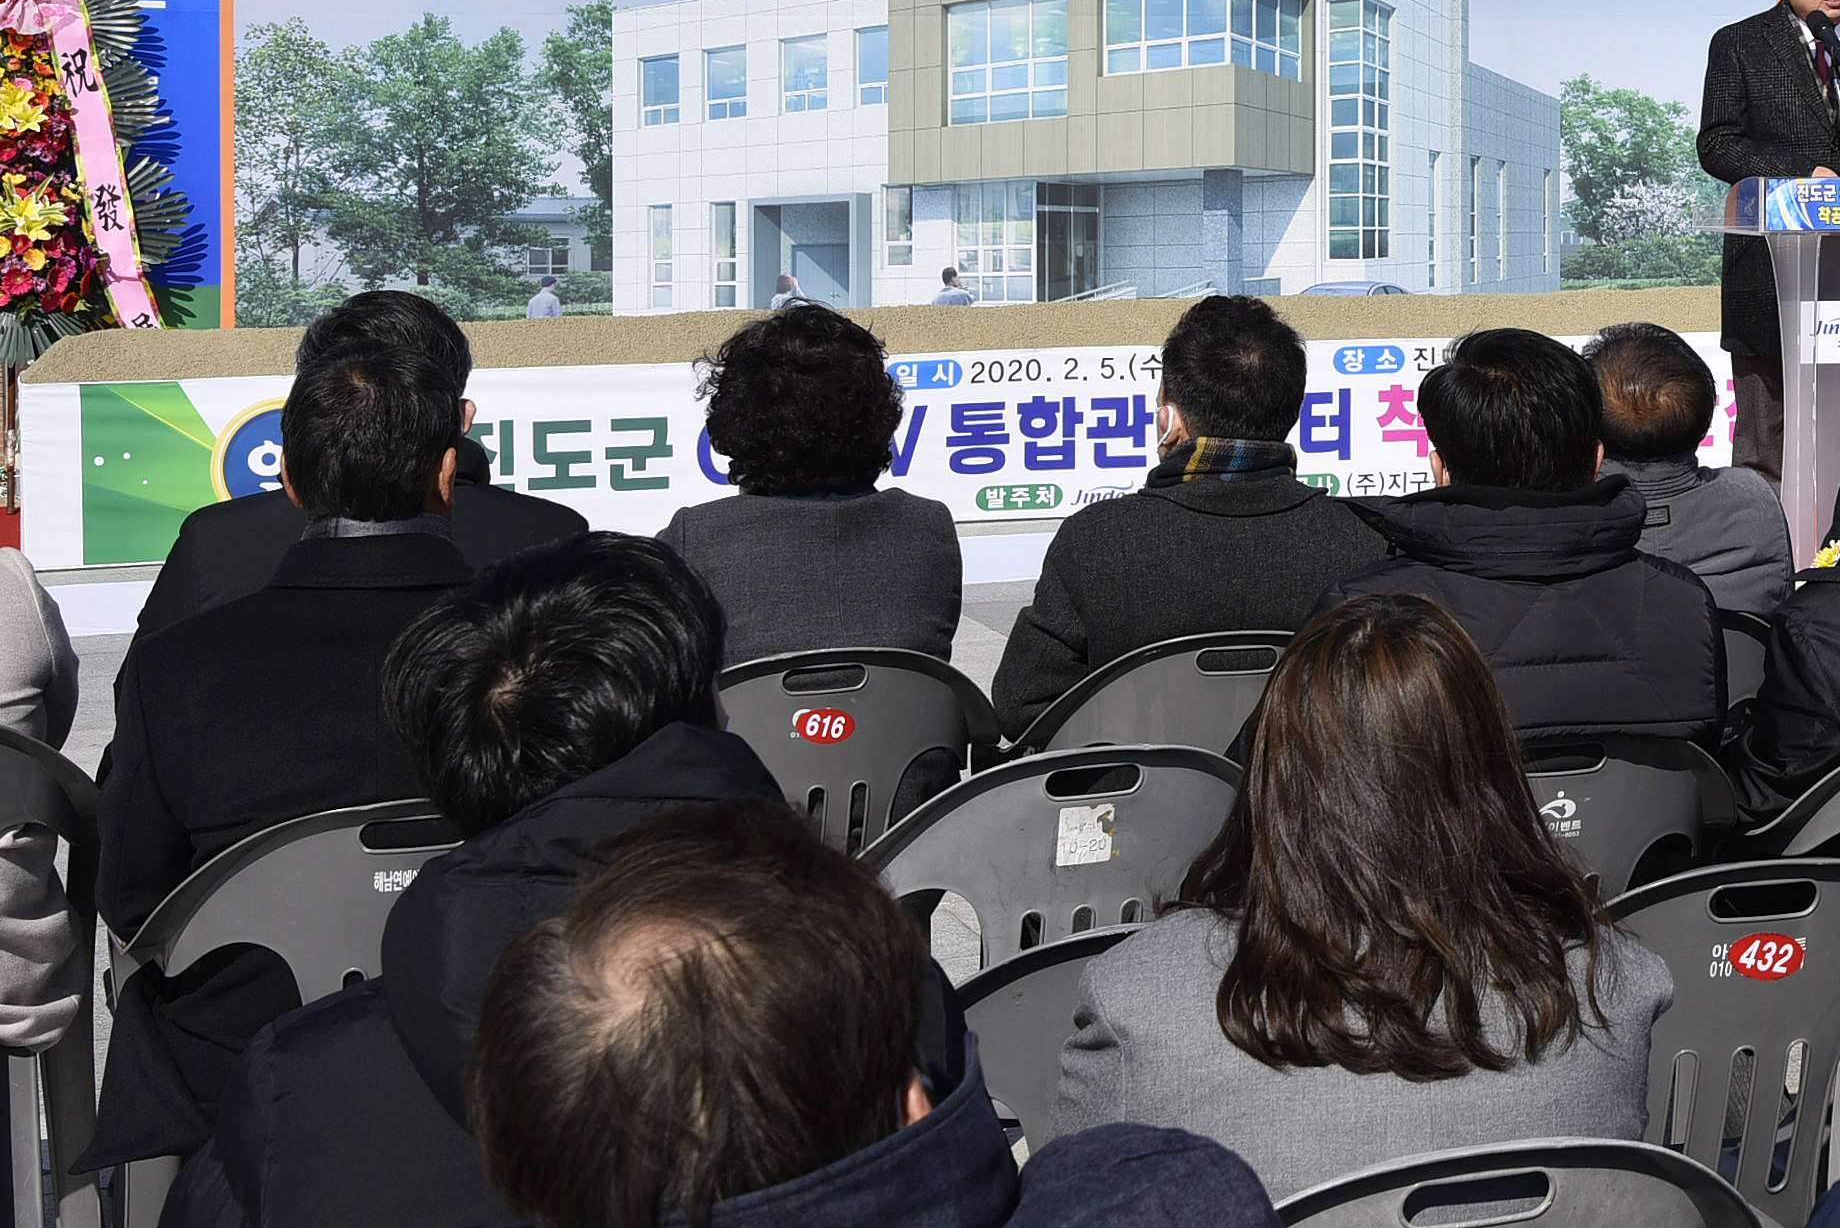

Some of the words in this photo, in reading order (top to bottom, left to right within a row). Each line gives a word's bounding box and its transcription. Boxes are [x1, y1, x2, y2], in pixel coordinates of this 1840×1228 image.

[1796, 184, 1837, 203] 진도군
[970, 358, 1052, 384] 2020.
[1064, 357, 1088, 382] 2.
[985, 484, 1057, 509] 발주처
[806, 713, 846, 739] 616
[1739, 939, 1794, 974] 432
